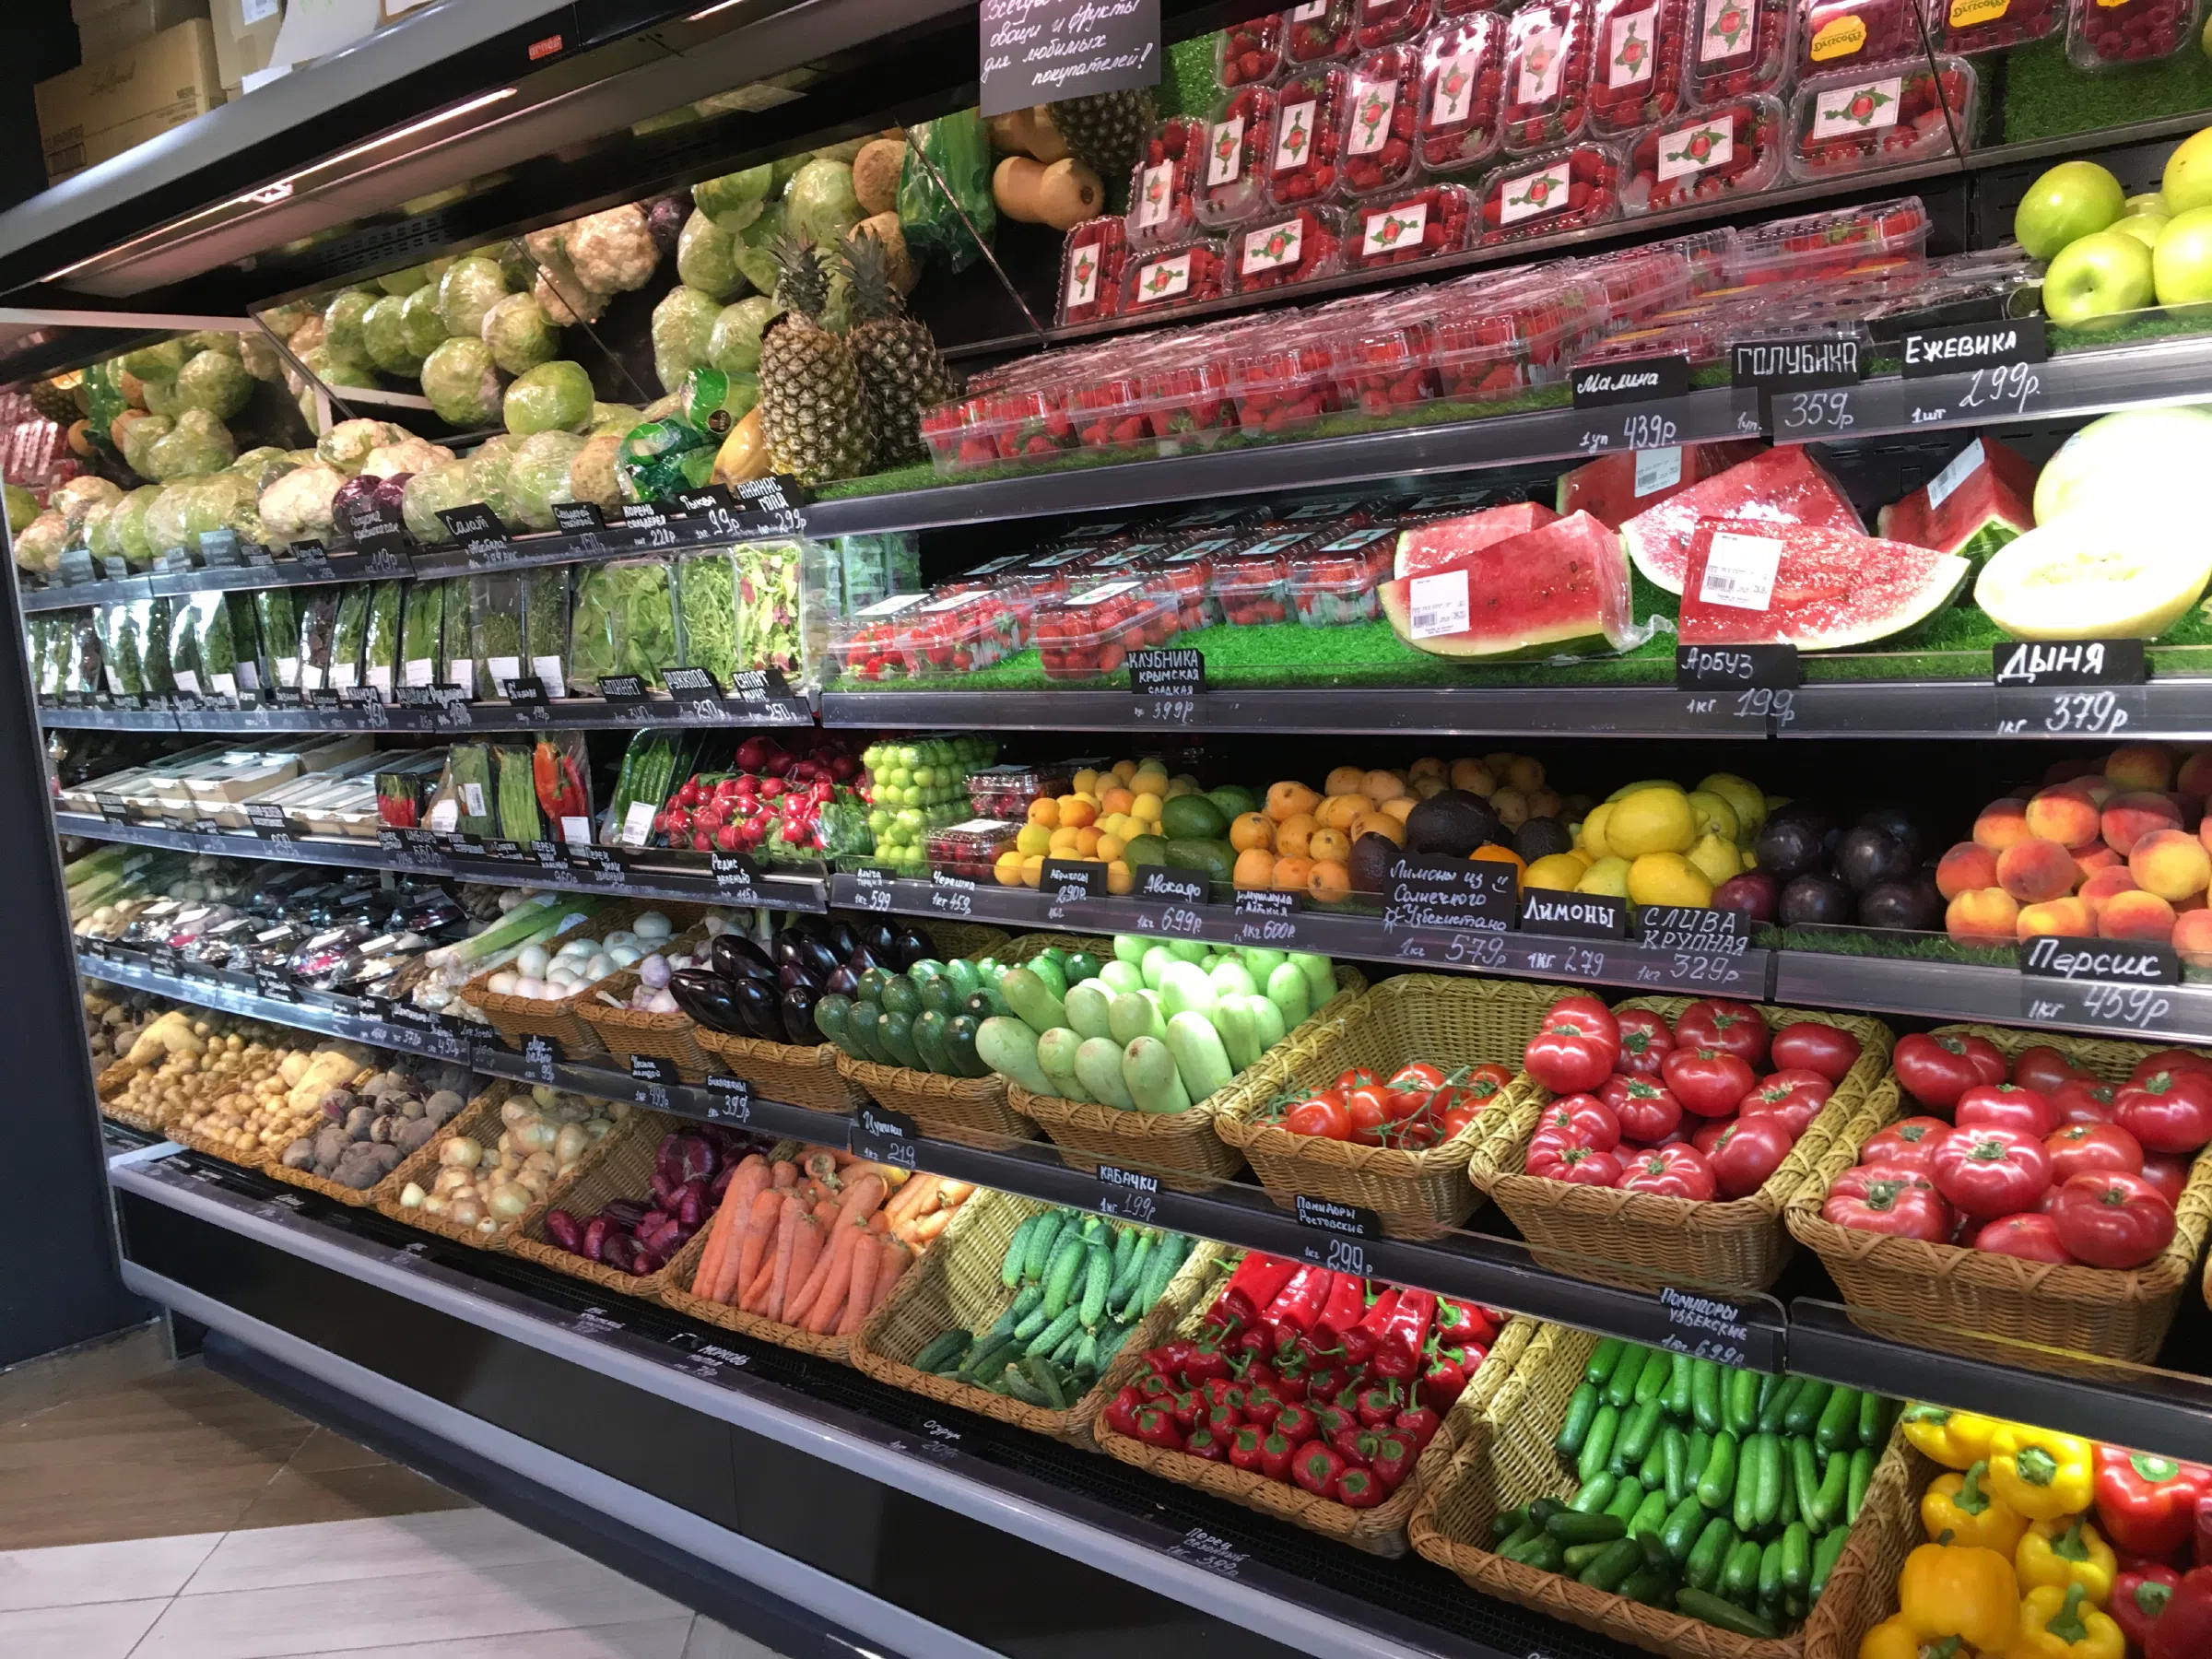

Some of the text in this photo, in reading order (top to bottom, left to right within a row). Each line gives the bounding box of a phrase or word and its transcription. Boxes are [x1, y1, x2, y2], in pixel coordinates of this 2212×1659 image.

[990, 0, 1141, 47] овощи и фрукты
[981, 35, 1107, 83] для любимых
[1031, 42, 1153, 87] покупателей!
[1737, 342, 1857, 375] ГОЛУБИКА
[1577, 372, 1659, 394] Малина
[1912, 407, 1947, 423] 1шт
[1580, 431, 1608, 453] 1уп
[737, 477, 782, 499] АНАНАС
[446, 515, 489, 535] Салат
[1128, 650, 1198, 668] КЛУБНИКА
[1997, 643, 2105, 684] ДЫНЯ
[1139, 670, 1199, 683] КРЫМСКАЯ
[1148, 685, 1193, 696] СЛАДКАЯ
[2045, 691, 2128, 736] 379р
[1050, 868, 1088, 883] Абрикосы
[1390, 859, 1483, 888] Лимоны из
[869, 890, 890, 911] 599
[1144, 874, 1201, 902] Авокадо
[1394, 883, 1487, 905] Солнечного
[1643, 907, 1736, 934] СЛИВА
[1395, 937, 1425, 957] 1кг
[1640, 930, 1748, 956] КРУПНАЯ
[1564, 946, 1605, 977] 279
[1637, 953, 1739, 983] 1кг 329р
[2029, 939, 2161, 979] Персик
[2083, 985, 2170, 1028] 459р
[1100, 1165, 1158, 1193] КАБАЧКИ
[1186, 1527, 1232, 1550] Перец
